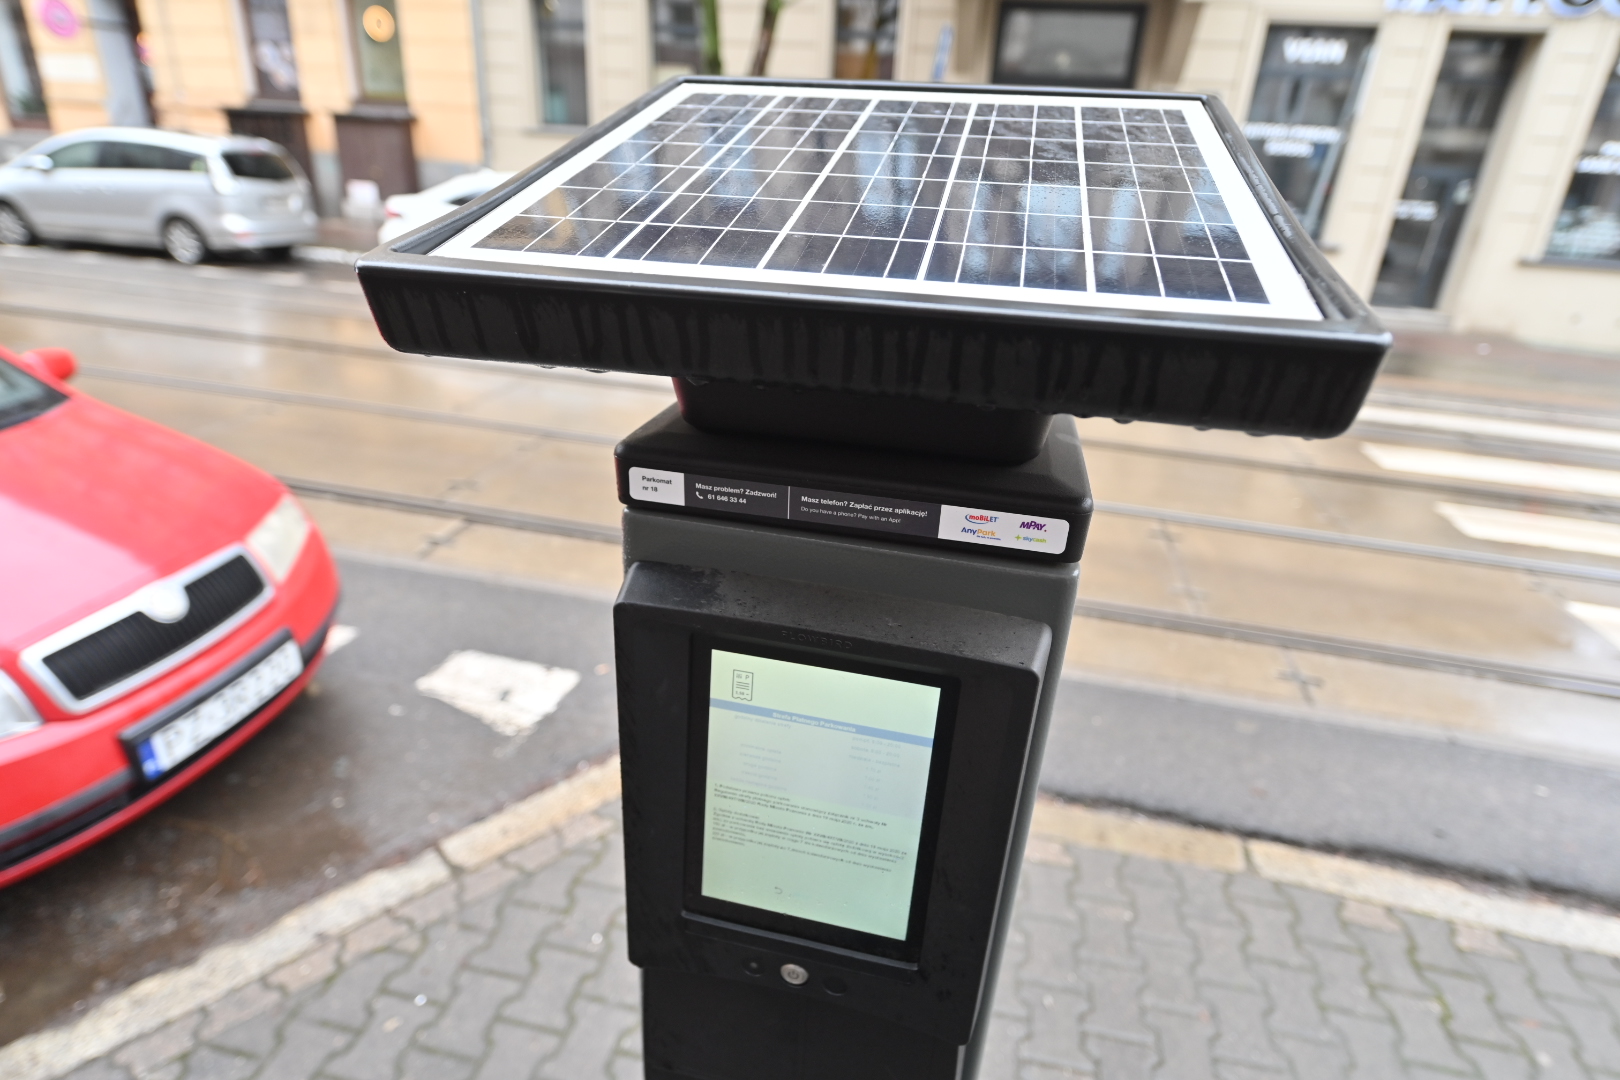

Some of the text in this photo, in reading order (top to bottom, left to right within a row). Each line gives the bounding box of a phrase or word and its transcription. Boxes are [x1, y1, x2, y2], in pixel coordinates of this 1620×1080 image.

[642, 476, 672, 485] Parkomat
[695, 482, 778, 498] Masz problem? Zadzwoń!
[820, 498, 848, 507] telefon?
[849, 501, 872, 511] Zapłać
[894, 507, 928, 518] aplikację!
[968, 514, 998, 523] moBiLET
[961, 527, 996, 536] AnyPark
